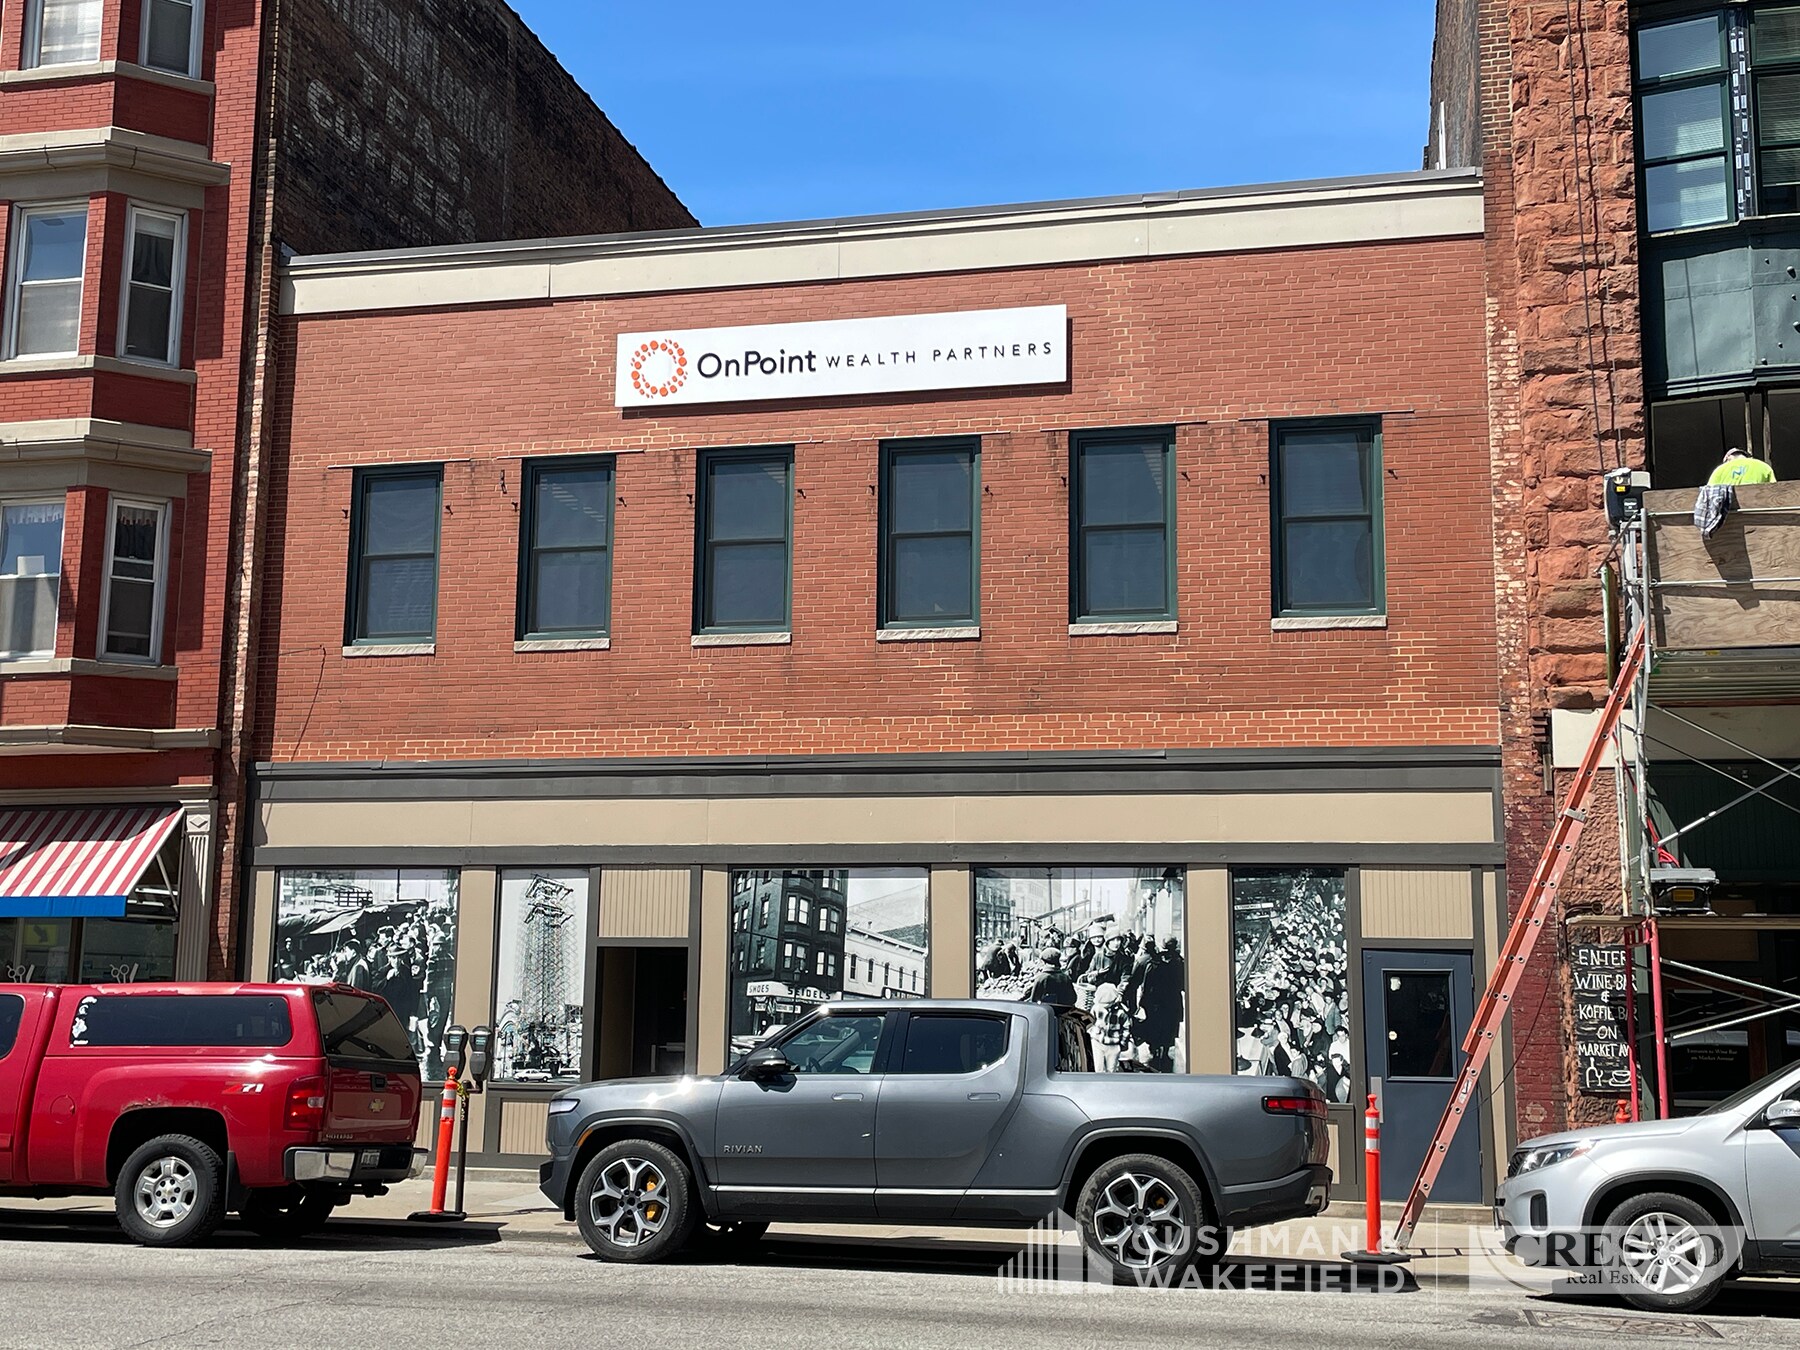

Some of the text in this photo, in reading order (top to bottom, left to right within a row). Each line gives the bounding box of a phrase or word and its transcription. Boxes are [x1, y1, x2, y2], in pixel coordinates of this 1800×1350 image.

[697, 342, 1051, 378] OnPoint WEALTH PARTNERS
[1573, 972, 1638, 991] WINE BR
[749, 985, 769, 994] SHOES
[1617, 1006, 1639, 1021] BR
[1596, 1025, 1618, 1040] ON
[1578, 1043, 1618, 1057] MARKET
[723, 1144, 763, 1154] RIVIAN
